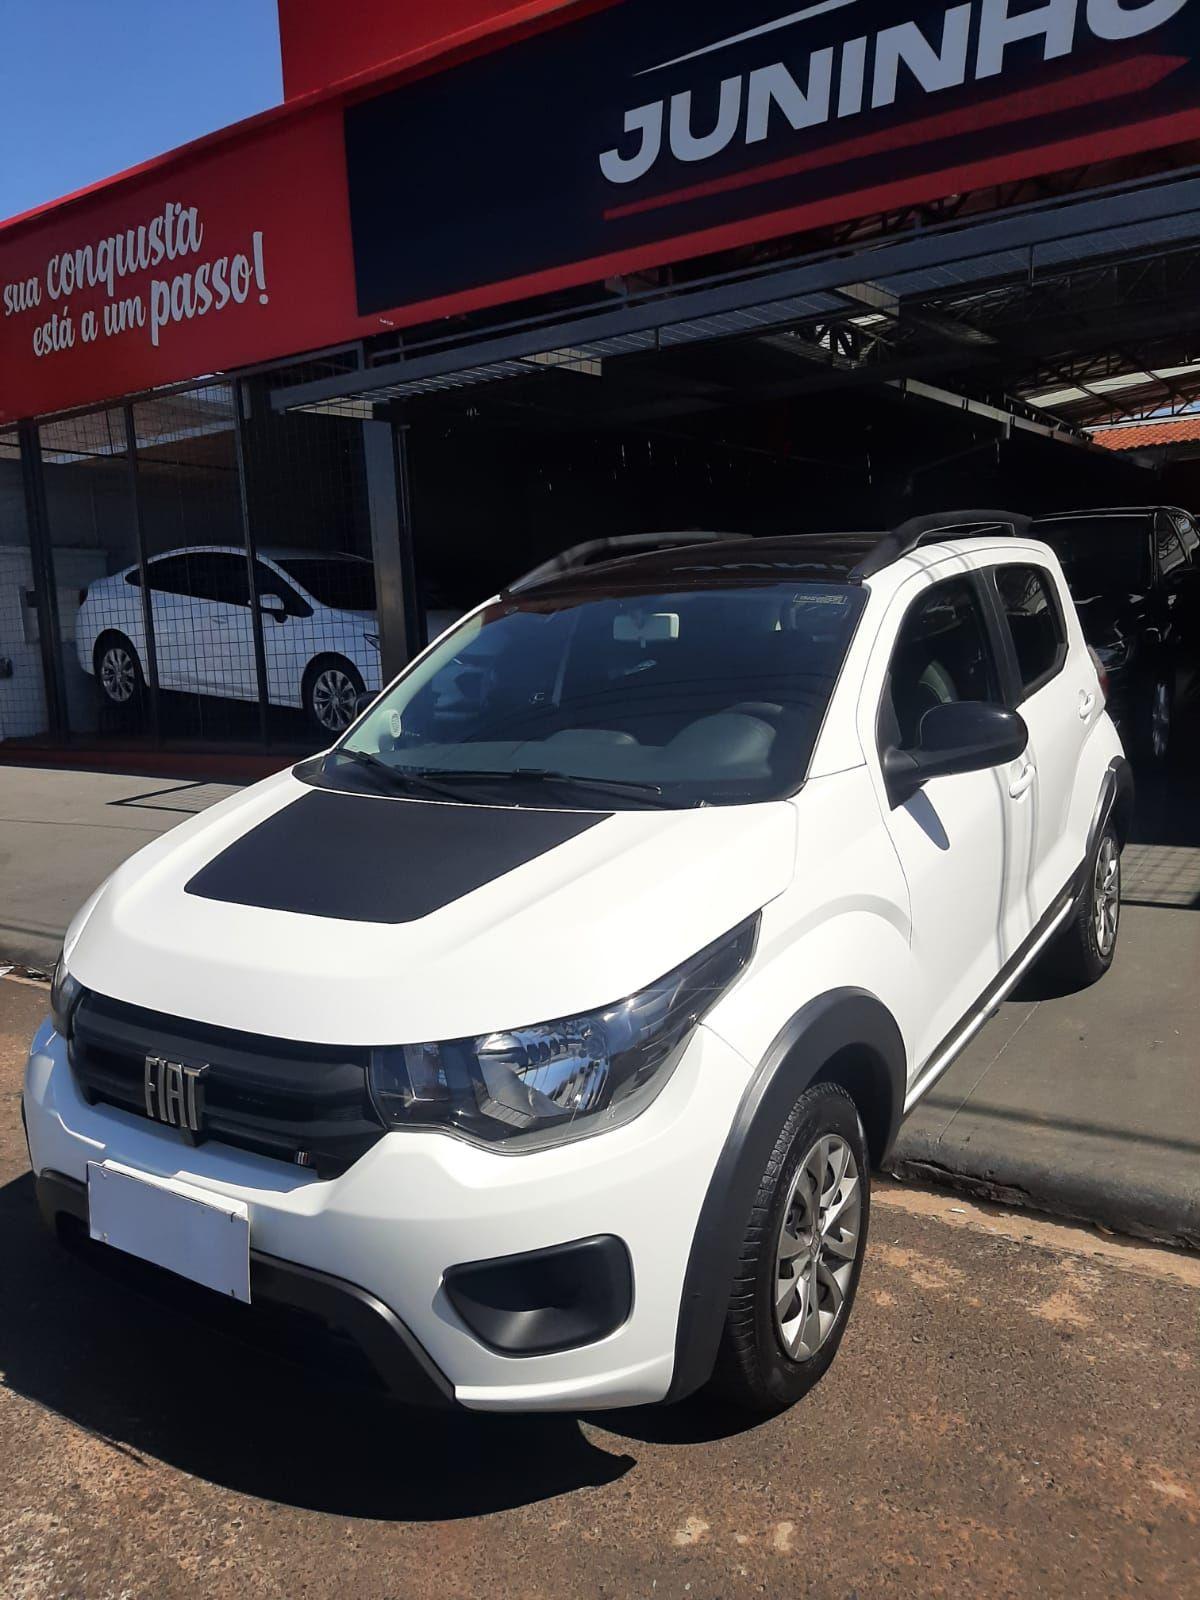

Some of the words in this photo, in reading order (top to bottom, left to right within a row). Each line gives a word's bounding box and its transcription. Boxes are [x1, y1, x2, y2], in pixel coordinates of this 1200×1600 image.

[3, 277, 41, 316] sua
[33, 305, 76, 357] está
[81, 311, 98, 342] a
[104, 295, 146, 337] um
[150, 231, 269, 347] passo!
[144, 1055, 204, 1132] FIAT
